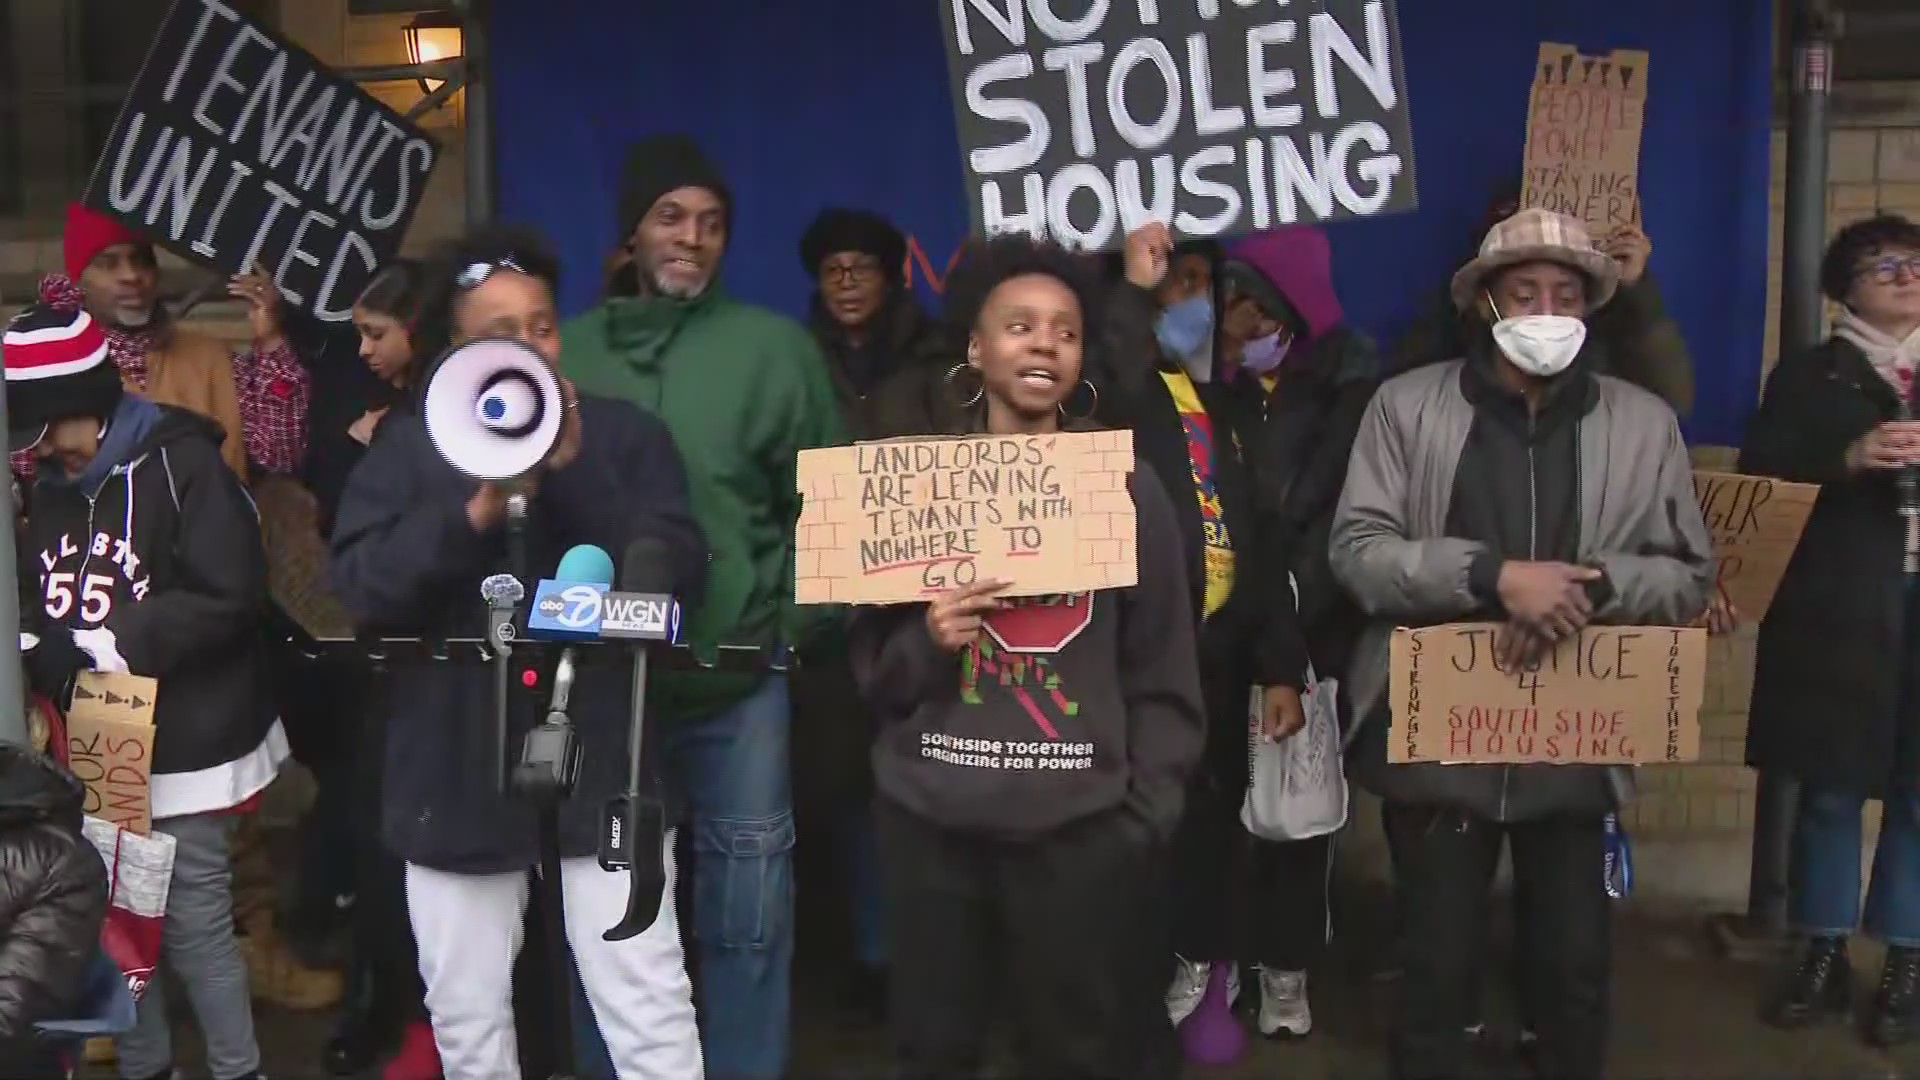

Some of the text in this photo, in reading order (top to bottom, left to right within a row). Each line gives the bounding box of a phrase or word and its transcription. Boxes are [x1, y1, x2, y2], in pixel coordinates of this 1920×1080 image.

[964, 1, 1398, 173] STOLEN
[163, 0, 433, 231] TENANTS
[980, 121, 1402, 252] HOUSING
[107, 112, 377, 322] UNITED
[861, 466, 1061, 510] ARE LEAVING
[866, 495, 1073, 537] TENANTS WITH
[861, 525, 1043, 572] NOWHERE TO
[922, 559, 978, 589] GO
[44, 572, 115, 623] 55
[539, 601, 565, 613] abc
[556, 586, 601, 628] 7
[605, 599, 666, 623] WGN
[1407, 631, 1422, 759] STRONGER
[1518, 671, 1546, 706] 4
[1667, 630, 1680, 761] TOGETHER
[1448, 705, 1625, 734] SOUTH SIDE
[1003, 757, 1035, 770] FOR
[1450, 729, 1635, 758] HOUSING
